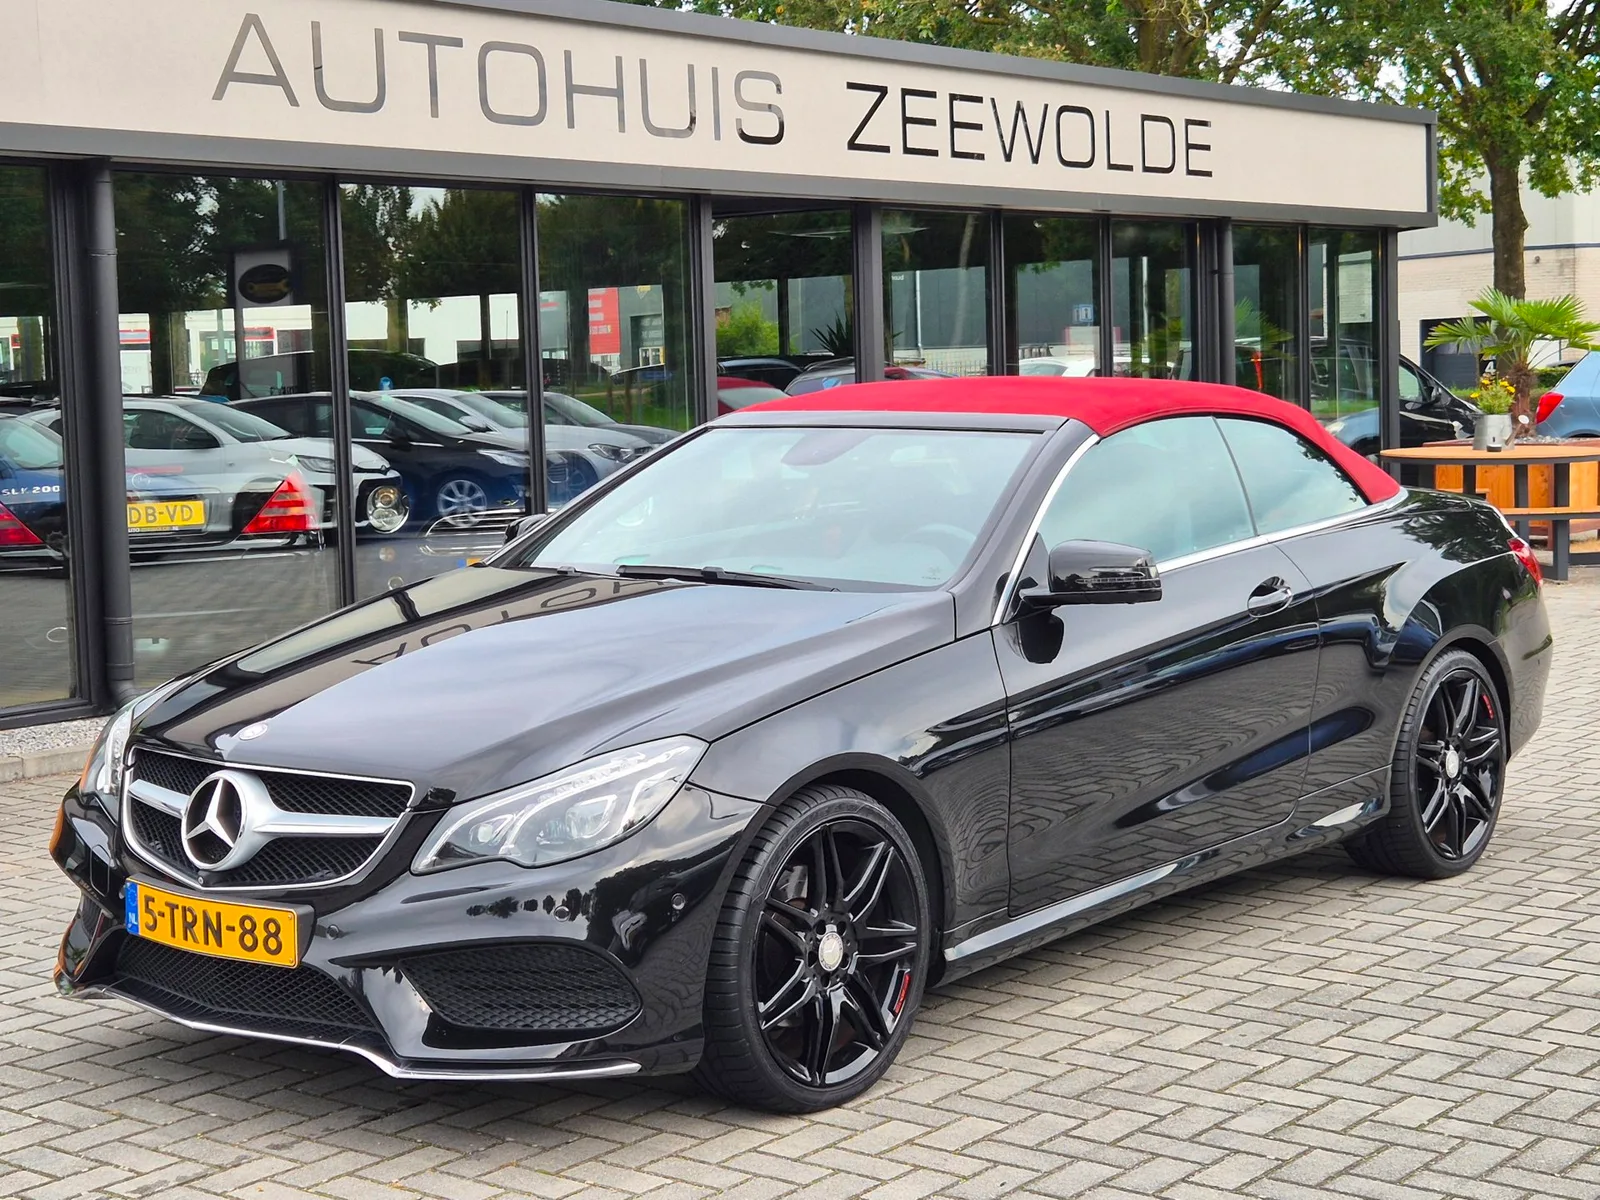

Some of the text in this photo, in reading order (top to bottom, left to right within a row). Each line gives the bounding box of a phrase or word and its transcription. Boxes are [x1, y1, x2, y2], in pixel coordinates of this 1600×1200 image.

[212, 13, 1213, 177] AUTOHUIS ZEEWOLDE
[1, 485, 60, 496] SLK 200
[128, 911, 138, 925] NL
[144, 894, 283, 956] 5-TRN-88
